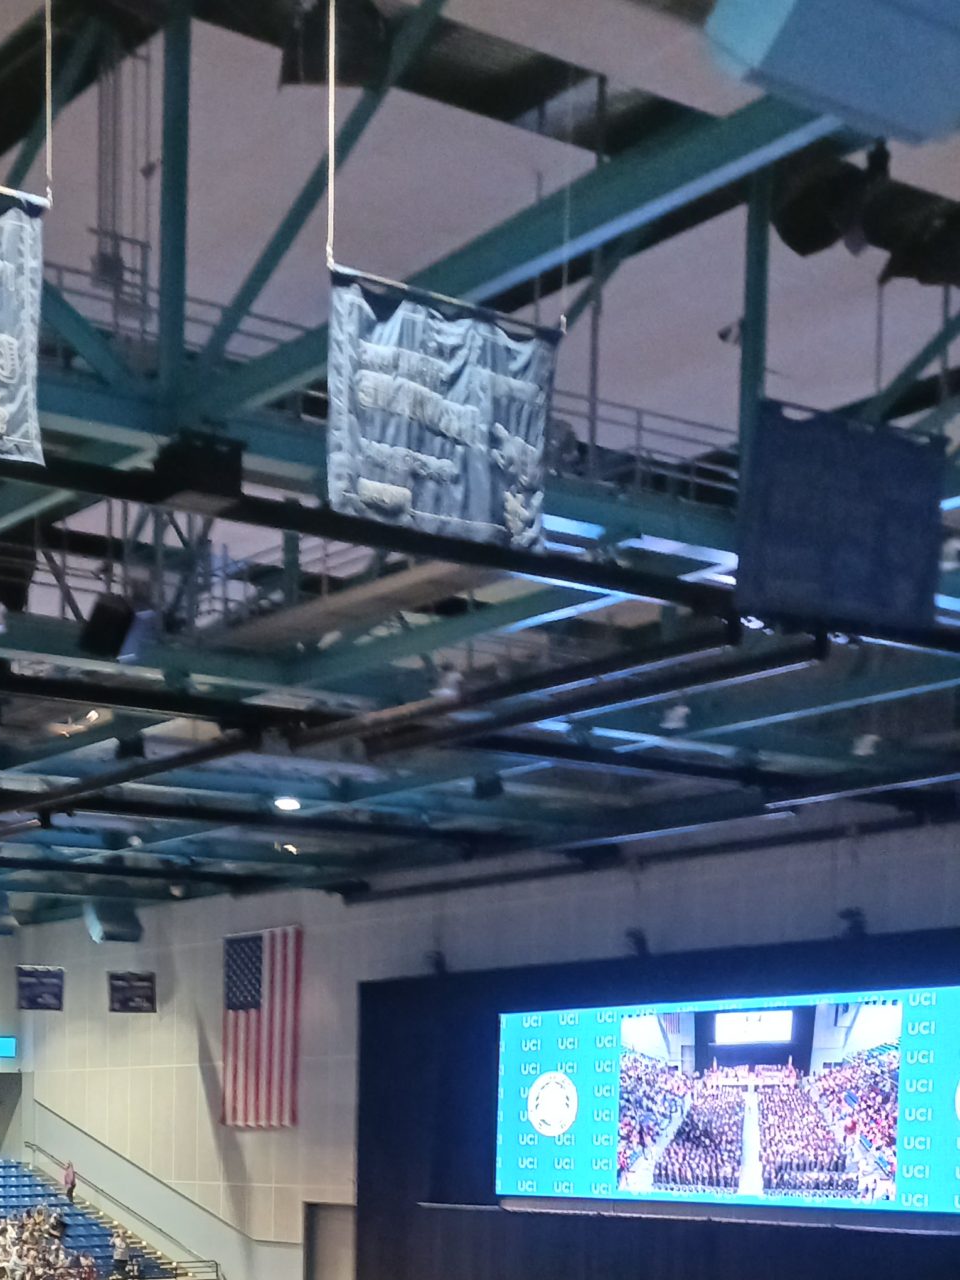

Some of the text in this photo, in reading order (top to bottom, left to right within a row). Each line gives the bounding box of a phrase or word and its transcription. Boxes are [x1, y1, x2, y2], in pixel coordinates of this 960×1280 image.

[908, 992, 937, 1006] UCI
[522, 1015, 542, 1028] UCI
[559, 1013, 579, 1025] UCI
[597, 1011, 617, 1023] UCI
[907, 1021, 936, 1035] UCI
[521, 1039, 541, 1051] UCI
[558, 1037, 578, 1050] UCI
[596, 1035, 617, 1048] UCI
[906, 1049, 934, 1064] UCI
[521, 1062, 540, 1075] UCI
[595, 1060, 616, 1073] UCI
[593, 1085, 615, 1097] UCI
[905, 1079, 933, 1092] UCI
[593, 1109, 614, 1121] UCI
[904, 1108, 932, 1121] UCI
[519, 1134, 538, 1146] UCI
[593, 1134, 613, 1146] UCI
[903, 1136, 931, 1150] UCI
[518, 1157, 538, 1169] UCI
[554, 1158, 575, 1170] UCI
[592, 1158, 612, 1170] UCI
[902, 1165, 930, 1178] UCI
[517, 1180, 537, 1192] UCI
[553, 1181, 573, 1193] UCI
[591, 1182, 612, 1194] UCI
[901, 1193, 929, 1207] UCI
